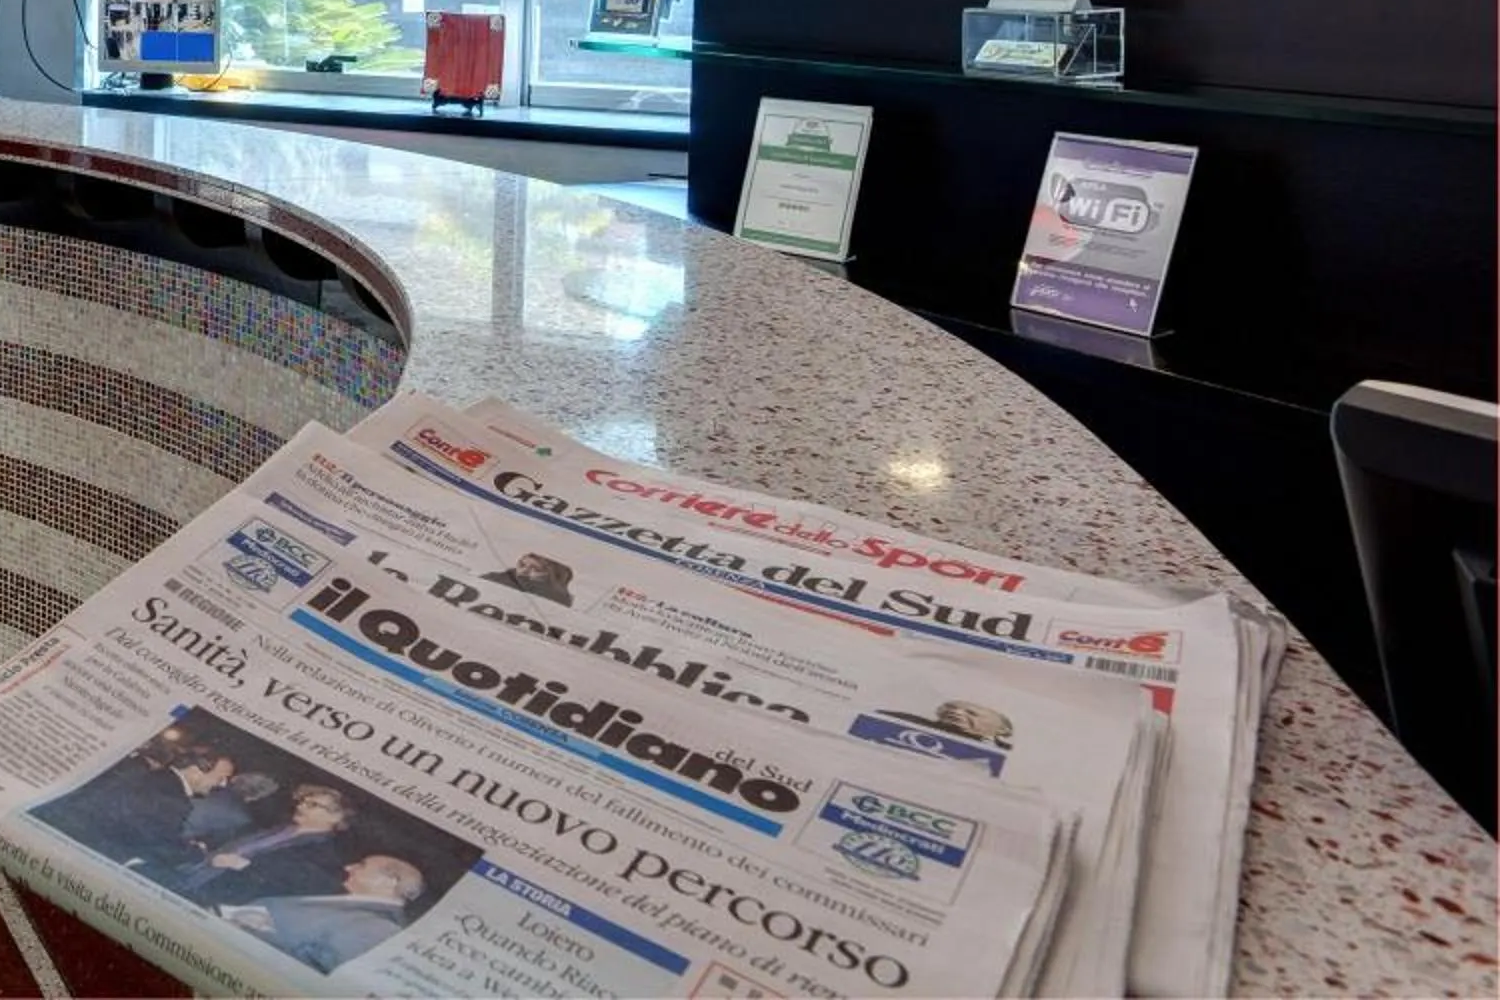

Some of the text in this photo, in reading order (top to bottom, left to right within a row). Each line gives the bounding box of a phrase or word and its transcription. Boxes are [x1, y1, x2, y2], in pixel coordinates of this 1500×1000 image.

[585, 468, 777, 529] Corriere
[773, 522, 849, 549] dello
[493, 470, 747, 571] Gazzetta
[761, 563, 868, 602] del
[880, 588, 1033, 642] Sud
[306, 577, 370, 623] il
[358, 608, 801, 813] Quotidiano
[131, 596, 250, 689] Sanità,
[262, 676, 376, 744] verso
[381, 739, 446, 777] un
[450, 770, 619, 857] nuovo
[616, 846, 911, 989] percorso
[253, 634, 295, 664] Nella
[296, 658, 375, 705] relazione
[374, 693, 398, 715] di
[564, 777, 603, 803] del
[599, 796, 723, 858] fallimento
[726, 848, 769, 881] dei
[772, 873, 933, 949] commissari
[713, 746, 816, 795] del Sud
[307, 737, 392, 787] richiesta
[396, 775, 446, 814] della
[444, 806, 624, 900] rinegoziazione
[621, 890, 666, 919] del
[657, 909, 748, 960] piano
[749, 953, 786, 977] di
[840, 809, 946, 855] Mediocrati
[886, 803, 959, 833] BCC
[486, 867, 573, 917] LA STORIA
[56, 875, 94, 904] visita
[94, 892, 134, 929] della
[134, 917, 246, 994] Commissione
[406, 939, 457, 972] idea
[517, 911, 596, 963] Loiero
